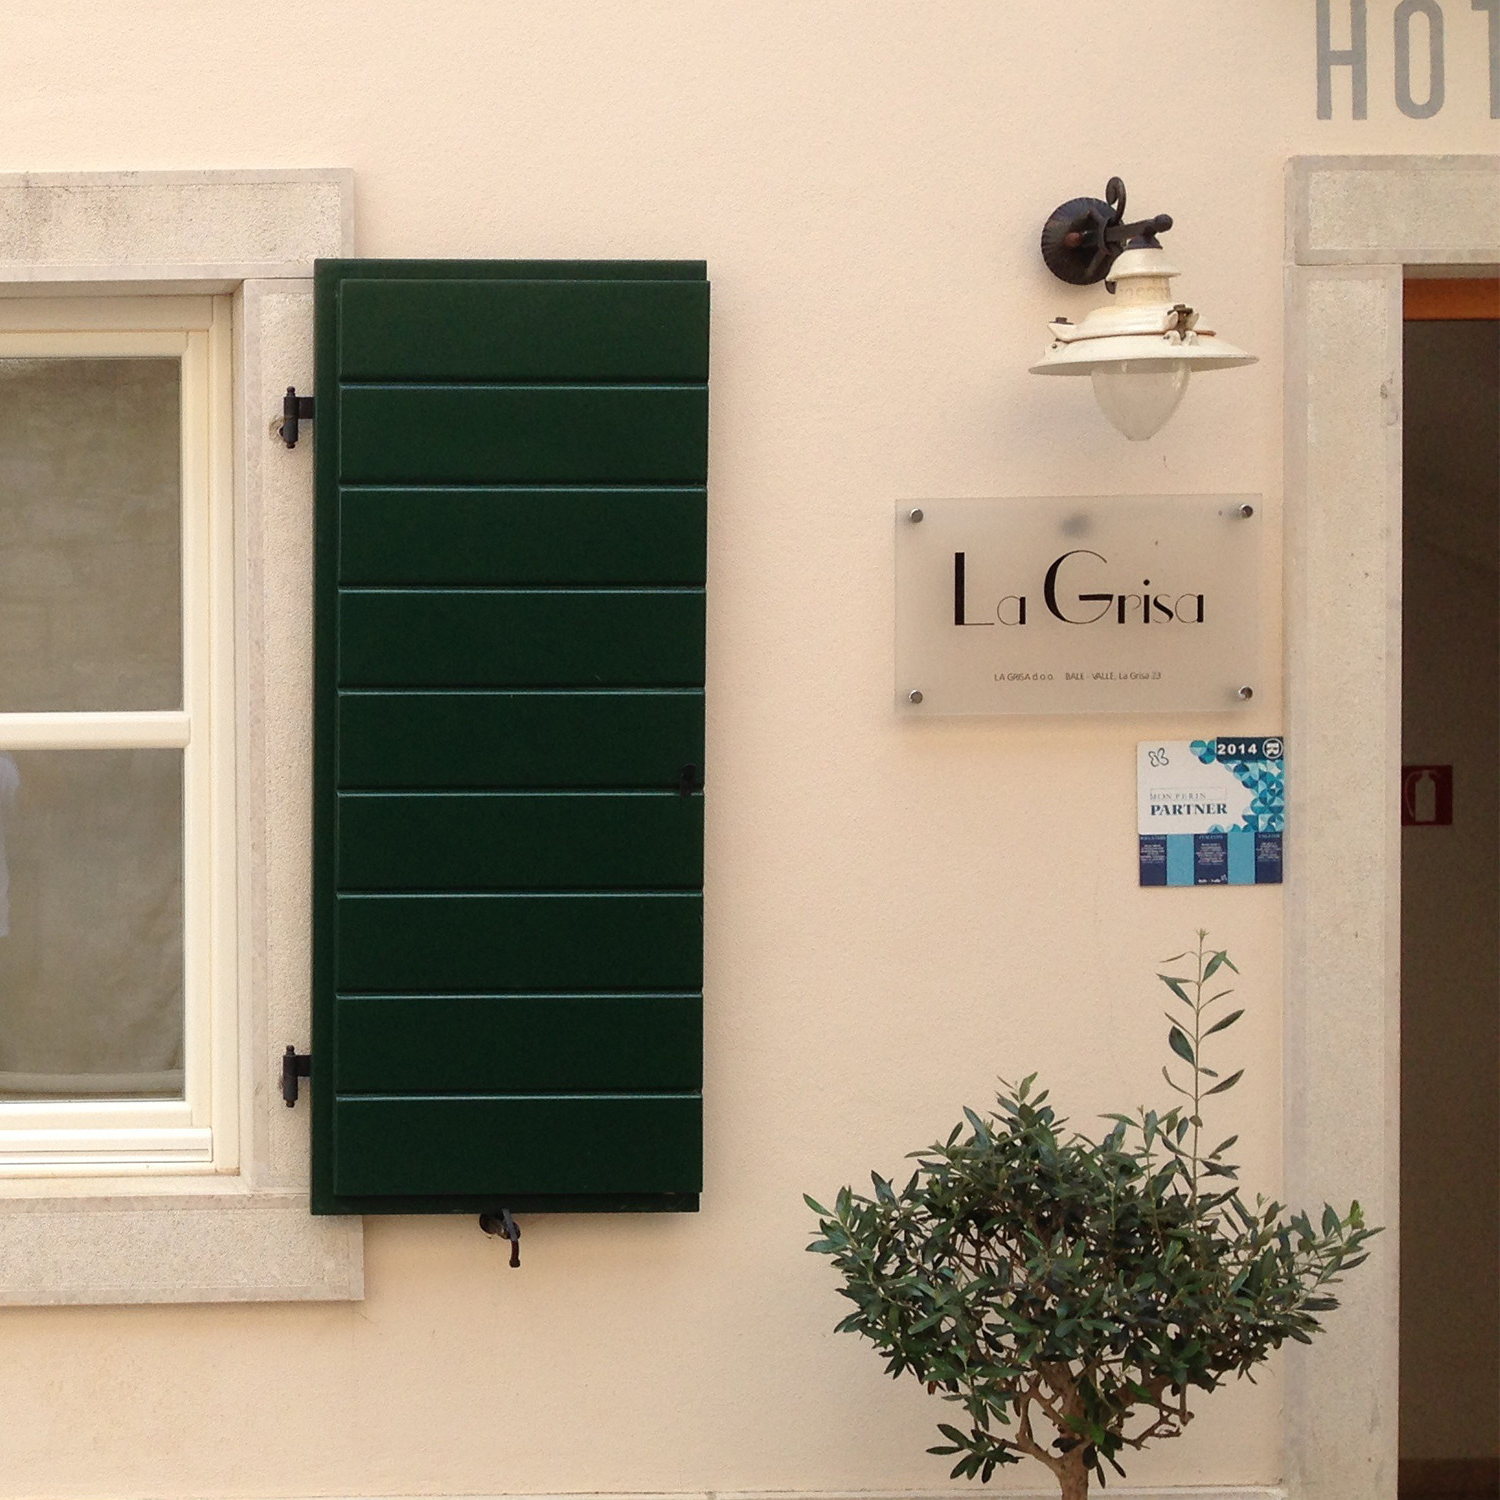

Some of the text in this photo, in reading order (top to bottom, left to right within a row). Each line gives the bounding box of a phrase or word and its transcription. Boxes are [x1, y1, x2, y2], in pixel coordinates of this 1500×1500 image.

[955, 550, 1204, 625] La Grisa
[994, 673, 1005, 682] LA
[1065, 672, 1084, 681] BALE
[1118, 672, 1128, 680] La
[1129, 672, 1150, 680] Grisa
[1217, 743, 1258, 755] 2014
[1175, 792, 1207, 800] PERIN
[1151, 803, 1228, 816] PARTNER
